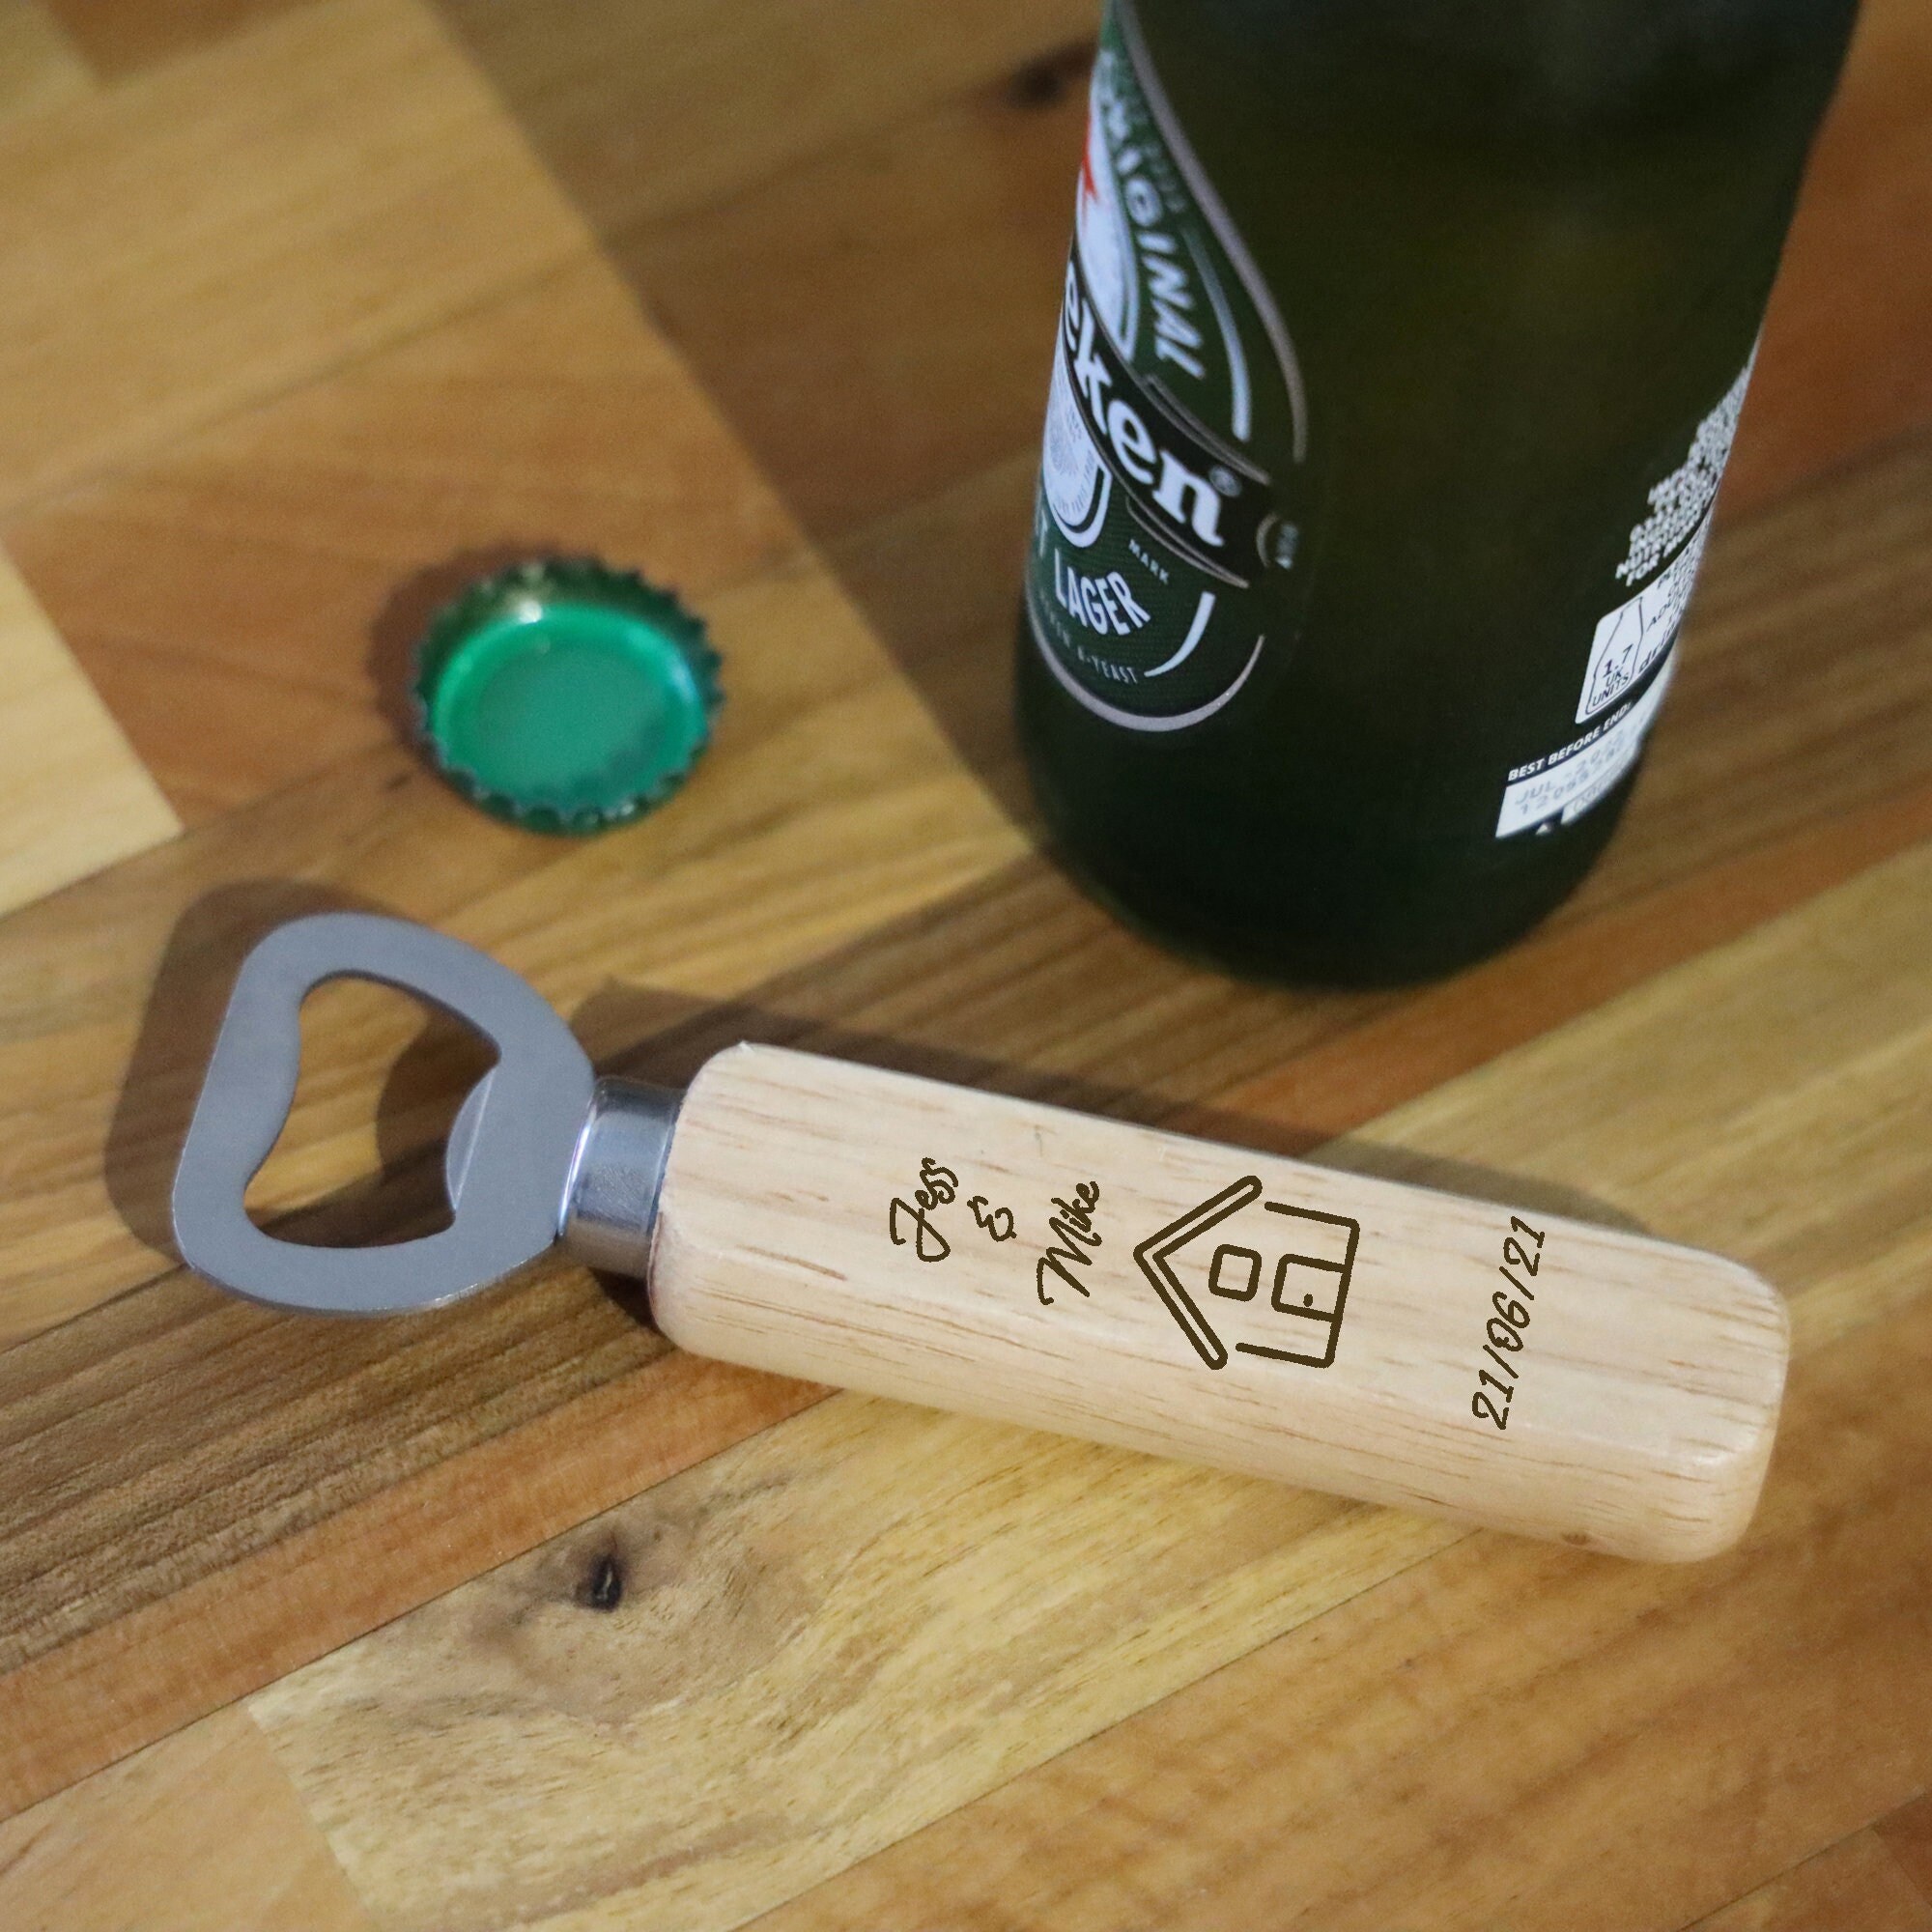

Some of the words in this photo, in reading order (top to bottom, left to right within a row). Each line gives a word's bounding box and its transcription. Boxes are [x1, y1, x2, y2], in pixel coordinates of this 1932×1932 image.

[1064, 259, 1225, 548] eken
[1054, 547, 1151, 636] LAGER
[1592, 672, 1631, 707] UNITS
[1603, 643, 1634, 678] 1.7
[1605, 666, 1624, 688] UK
[1507, 757, 1546, 782] BEST
[1548, 725, 1602, 766] BEFORE
[889, 1156, 958, 1263] Jess
[1036, 1180, 1102, 1305] Mike
[1471, 1215, 1546, 1431] 21/06/21
